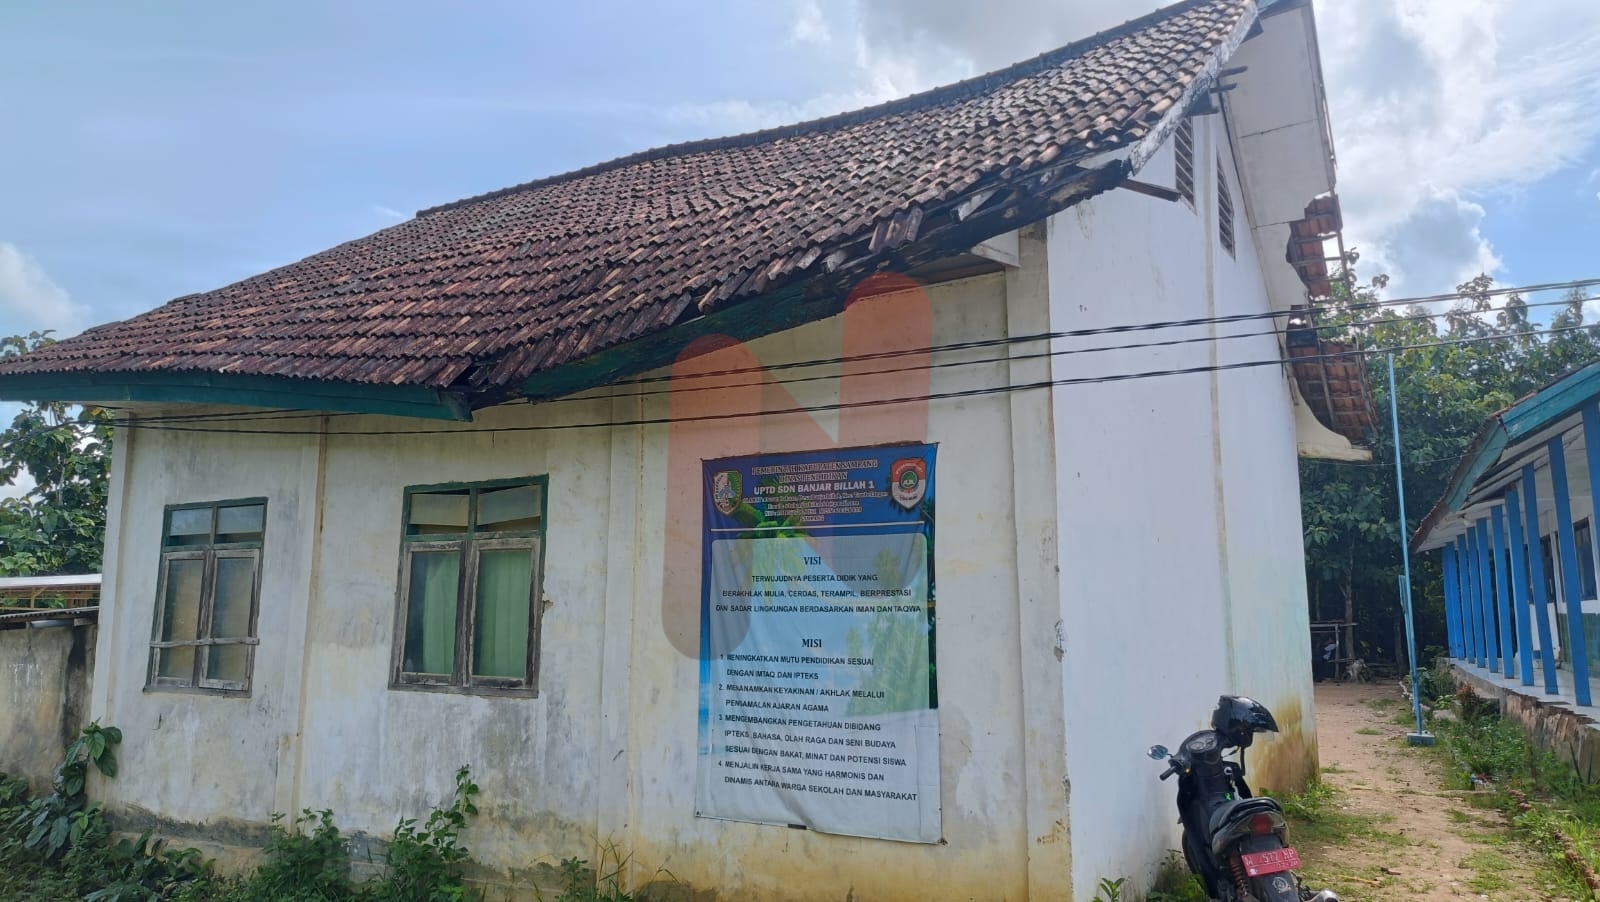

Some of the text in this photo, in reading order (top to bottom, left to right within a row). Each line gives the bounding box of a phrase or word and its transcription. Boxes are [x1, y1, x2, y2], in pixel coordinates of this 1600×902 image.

[754, 481, 875, 495] UPTD SDN BANJAR BILLAH 1
[803, 556, 821, 565] VISI
[803, 574, 835, 582] PESERTA
[764, 590, 786, 598] MULIA,
[788, 590, 819, 598] CERDAS,
[860, 589, 912, 597] BERPRESTASI
[799, 605, 854, 613] BERDASARKAN
[856, 605, 875, 613] IMAN
[876, 605, 893, 613] DAN
[894, 605, 921, 613] TAQWA
[801, 638, 822, 648] MISI
[780, 656, 799, 664] MUTU
[801, 657, 846, 665] PENDIDIKAN
[847, 658, 874, 666] SESUAI
[726, 669, 818, 680] DENGAN IMTAQ DAN IPTEKS
[774, 687, 815, 695] KEYAKINAN
[815, 688, 819, 696] /
[820, 689, 850, 697] AKHLAK
[852, 690, 885, 698] MELALUI
[772, 702, 801, 710] AJARAN
[802, 704, 829, 712] AGAMA
[725, 714, 786, 726] MENGEMBANGKAN
[788, 719, 843, 729] PENGETAHUAN
[844, 722, 881, 731] DIBIDANG
[784, 734, 803, 743] OLAH
[805, 736, 827, 744] RAGA
[828, 737, 844, 746] DAN
[845, 739, 863, 747] SENI
[864, 740, 896, 749] BUDAYA
[725, 745, 907, 766] SESUAI DENGAN BAKAT, MINAT DAN POTENSI SISWA
[725, 760, 759, 770] MENJALIN
[760, 764, 781, 773] KERJA
[782, 766, 802, 775] SAMA
[803, 768, 823, 777] YANG
[824, 770, 866, 780] HARMONIS
[867, 773, 884, 781] DAN
[724, 776, 917, 801] DINAMIS ANTARA WARGA SEKOLAH DAN MASYARAKAT
